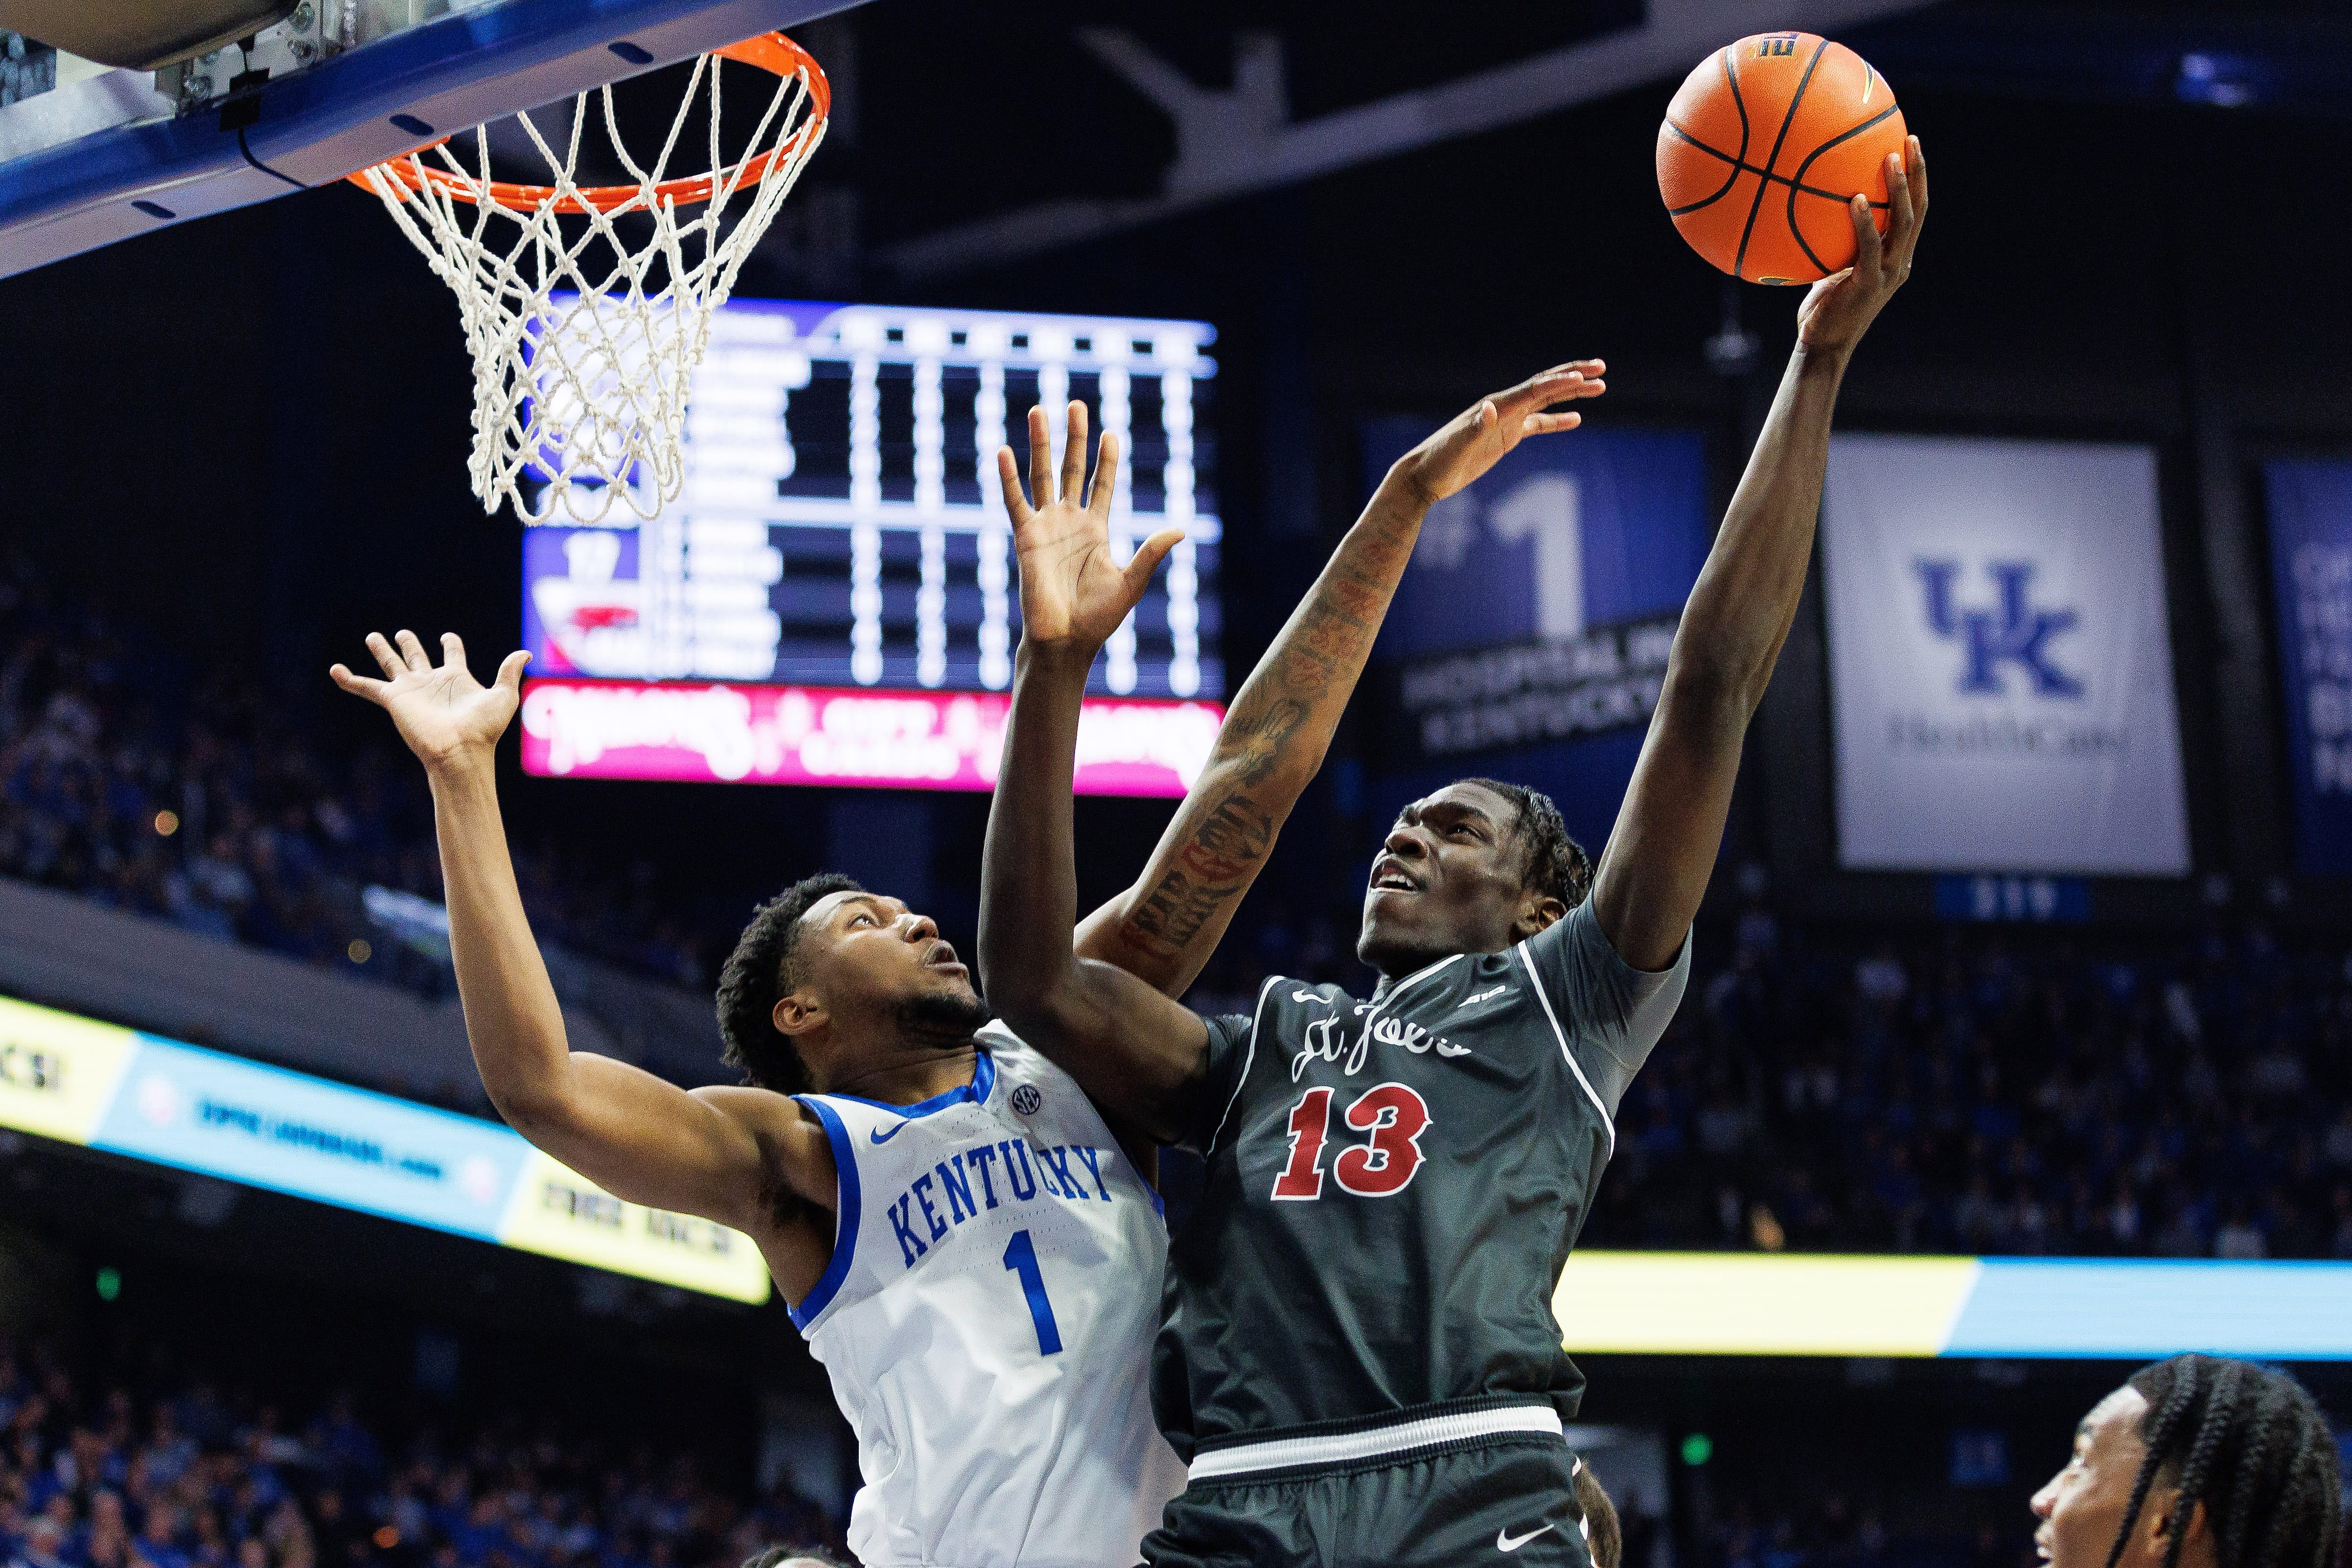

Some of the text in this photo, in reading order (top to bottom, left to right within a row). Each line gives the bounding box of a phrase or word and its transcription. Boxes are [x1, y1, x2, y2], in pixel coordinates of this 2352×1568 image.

[1910, 556, 2086, 701] UK
[1270, 1082, 1433, 1201] 13
[1002, 1229, 1063, 1357] 1
